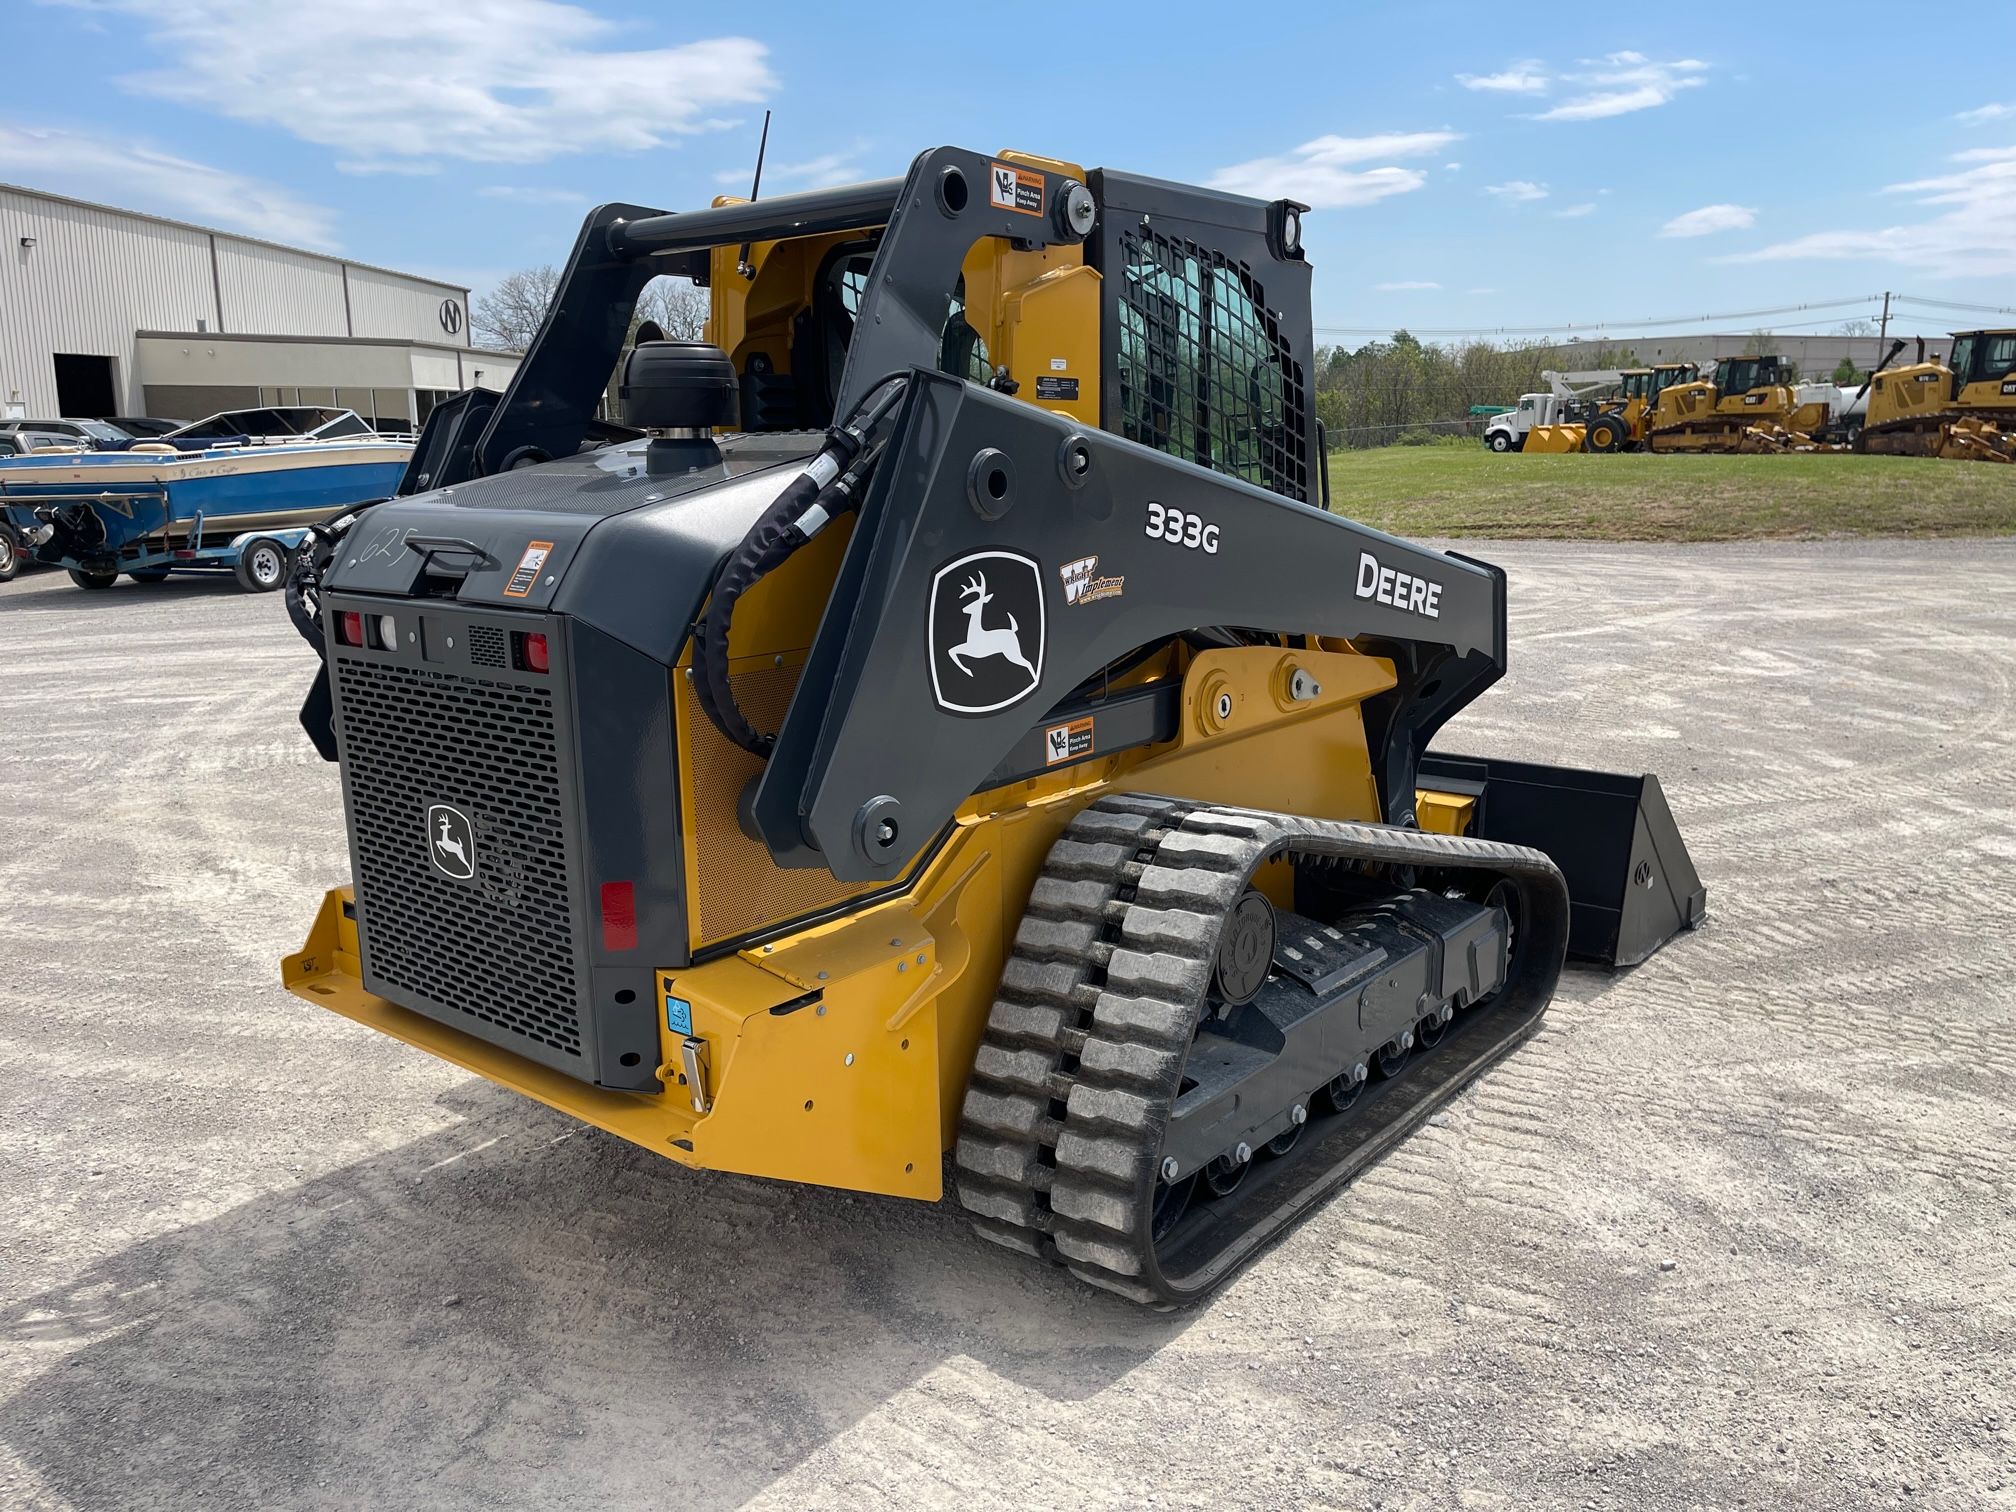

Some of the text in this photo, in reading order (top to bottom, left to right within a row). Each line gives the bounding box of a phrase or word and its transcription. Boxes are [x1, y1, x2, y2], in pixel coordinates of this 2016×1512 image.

[1023, 174, 1042, 185] WARNING
[1017, 188, 1041, 200] Pinch Area
[1017, 197, 1037, 208] Keep Away
[2003, 384, 2016, 393] CAT
[1145, 502, 1220, 554] 333G
[360, 526, 418, 567] 625
[1080, 577, 1124, 596] Implement
[1356, 552, 1442, 618] DEERE
[1069, 733, 1091, 745] Pinch Area
